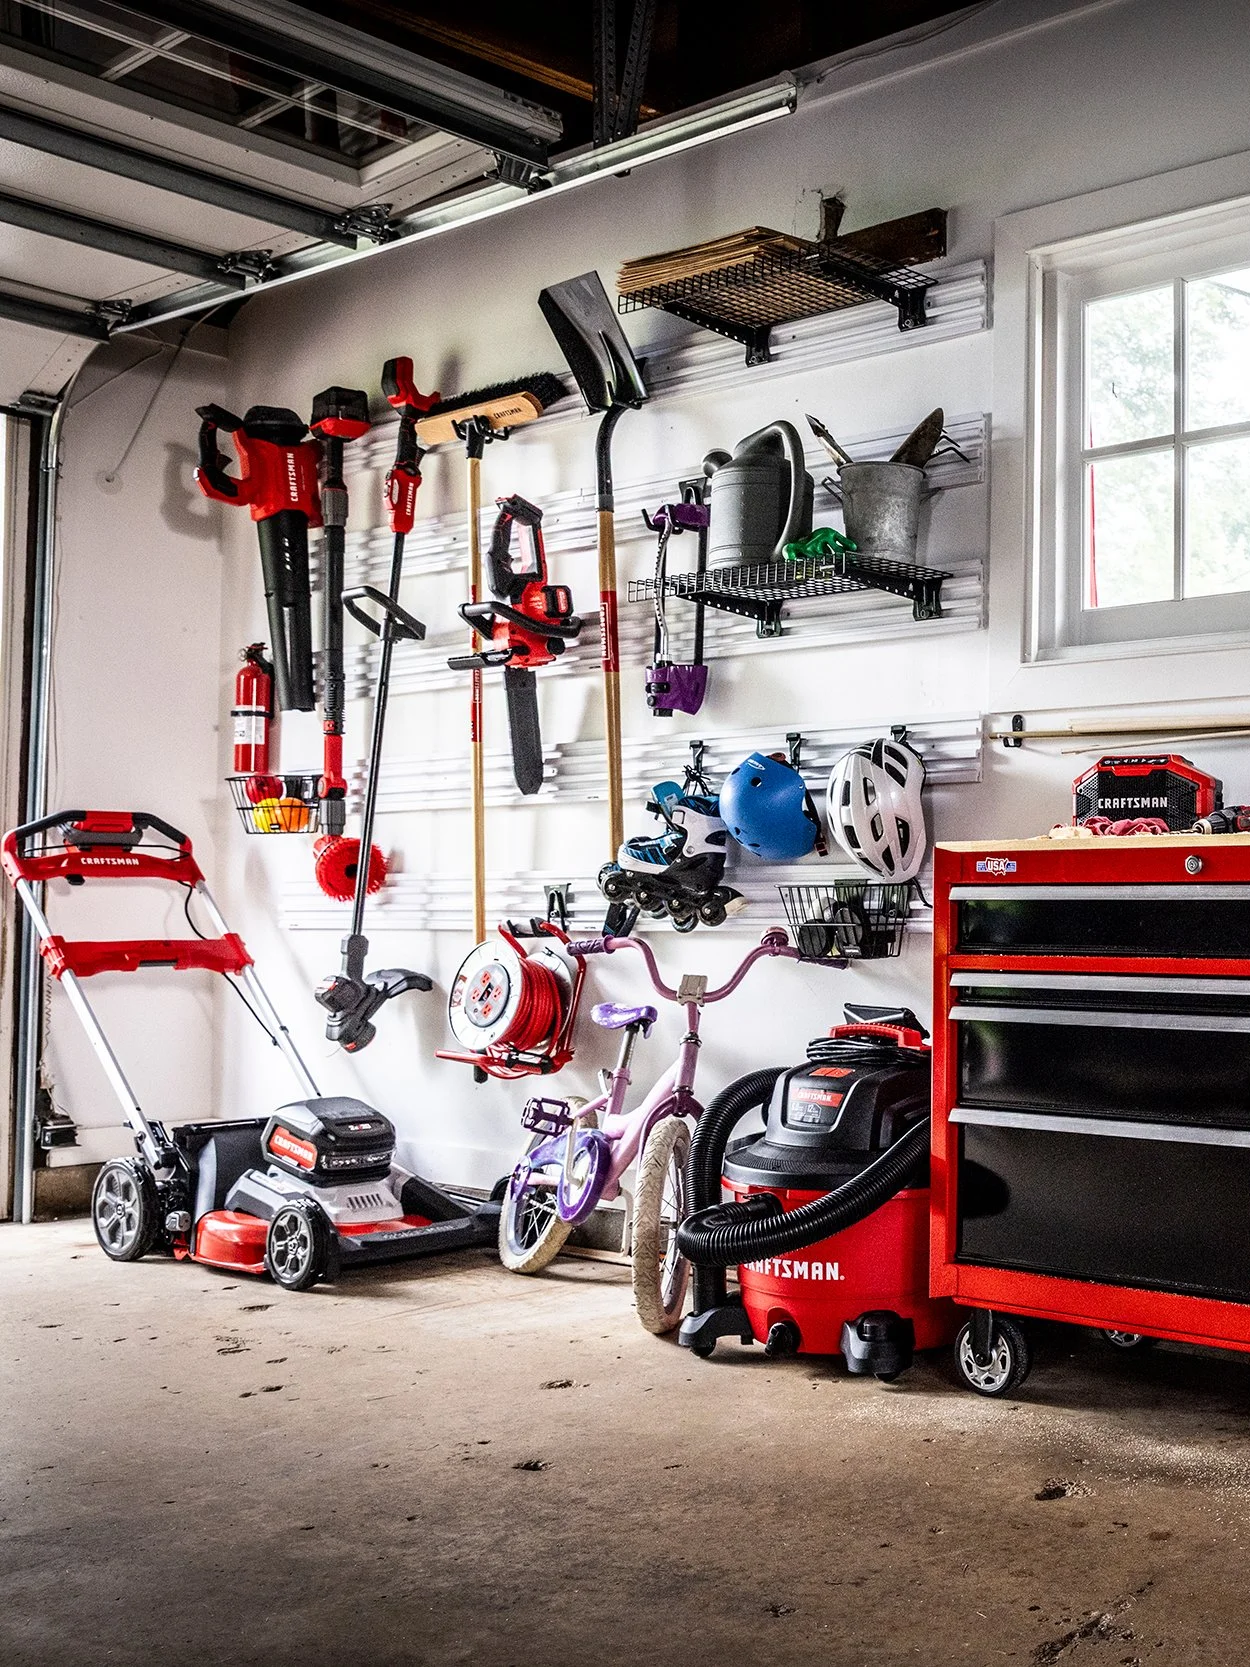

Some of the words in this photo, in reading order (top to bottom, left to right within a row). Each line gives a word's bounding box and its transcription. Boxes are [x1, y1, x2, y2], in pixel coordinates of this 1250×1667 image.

[493, 407, 522, 419] CRAFTSMAN
[286, 452, 299, 502] CRAFTSMAN
[405, 482, 414, 516] CRAFTSMAN
[1098, 796, 1168, 809] CRAFTSMAN
[80, 857, 140, 866] CRAFTSMAN
[987, 860, 1005, 871] USA
[274, 1135, 315, 1162] CRAFTSMAN
